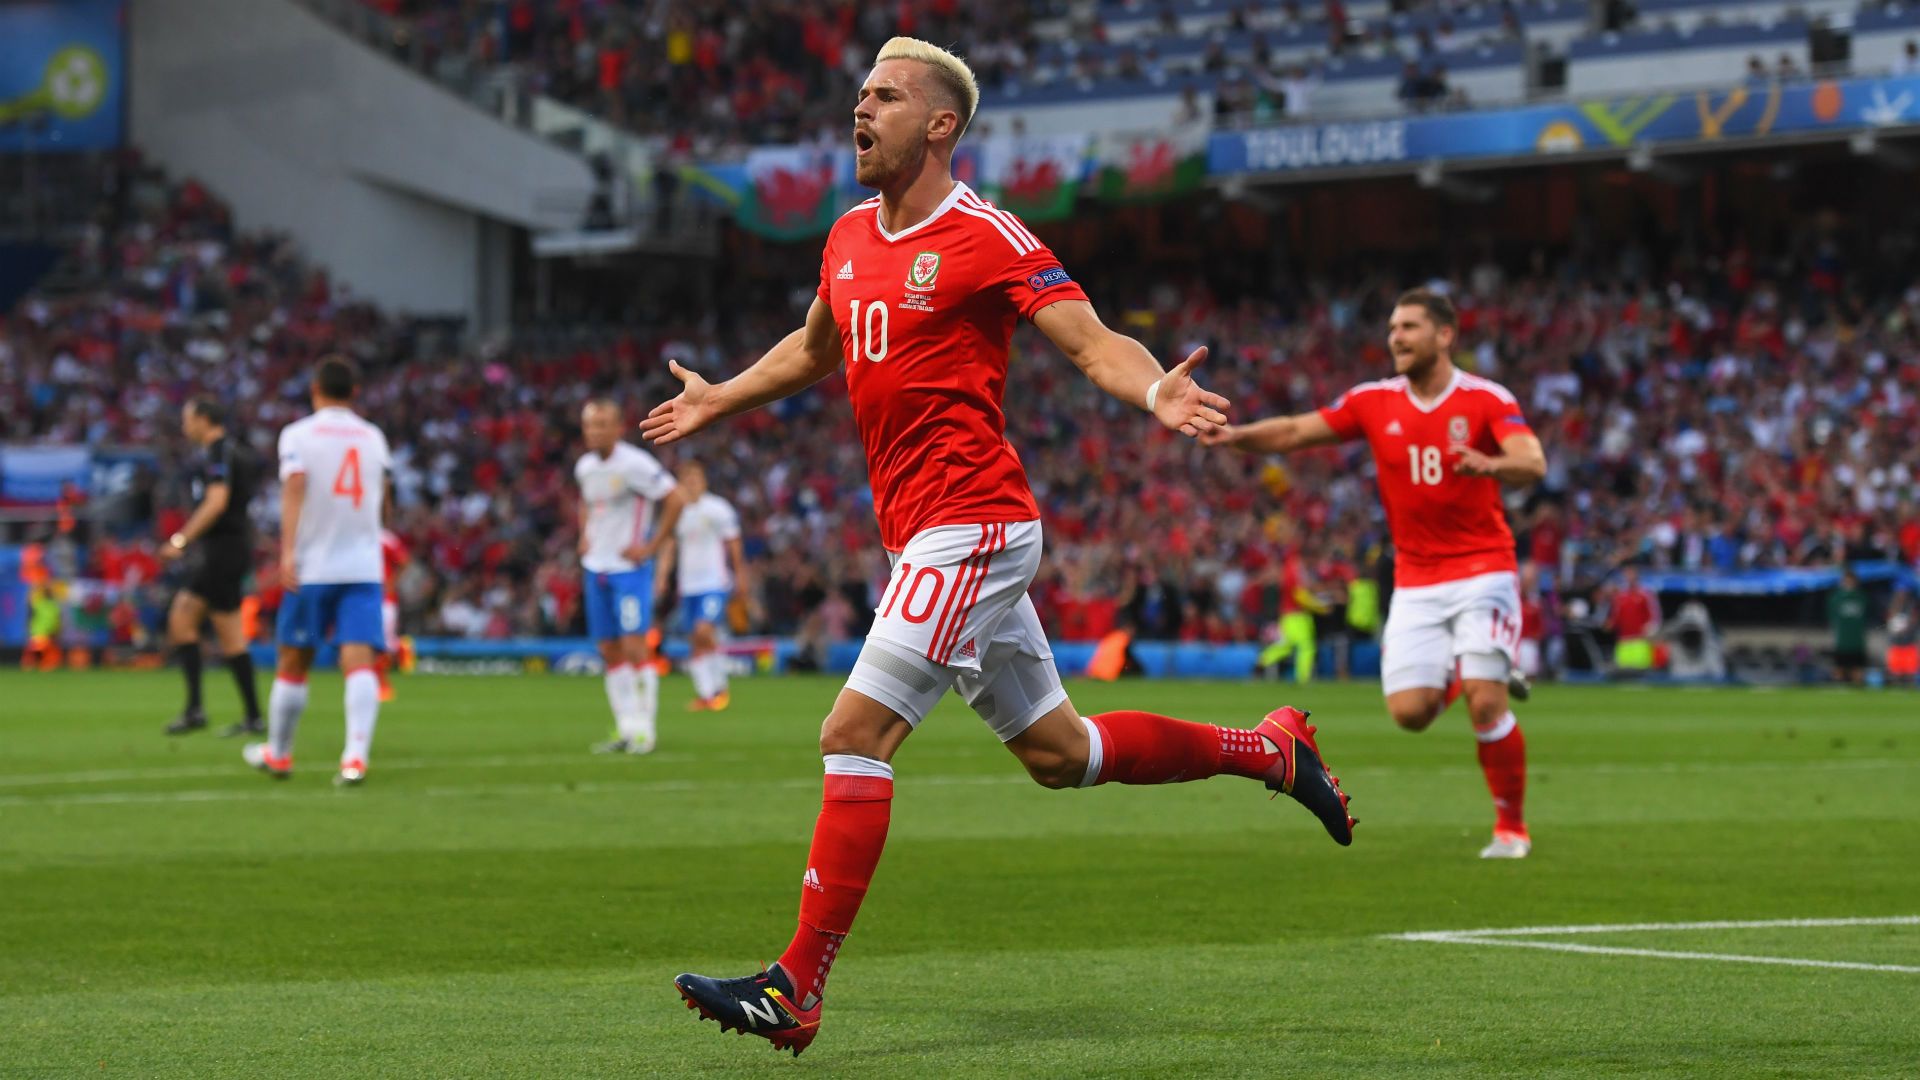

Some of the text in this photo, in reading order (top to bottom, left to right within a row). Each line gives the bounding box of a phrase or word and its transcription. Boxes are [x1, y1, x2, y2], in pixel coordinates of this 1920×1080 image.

[1246, 121, 1405, 168] TOULOUSE
[1043, 271, 1069, 283] RESPE
[849, 299, 889, 362] 10
[333, 446, 364, 512] 4
[1407, 444, 1443, 486] 18
[882, 562, 945, 624] 10
